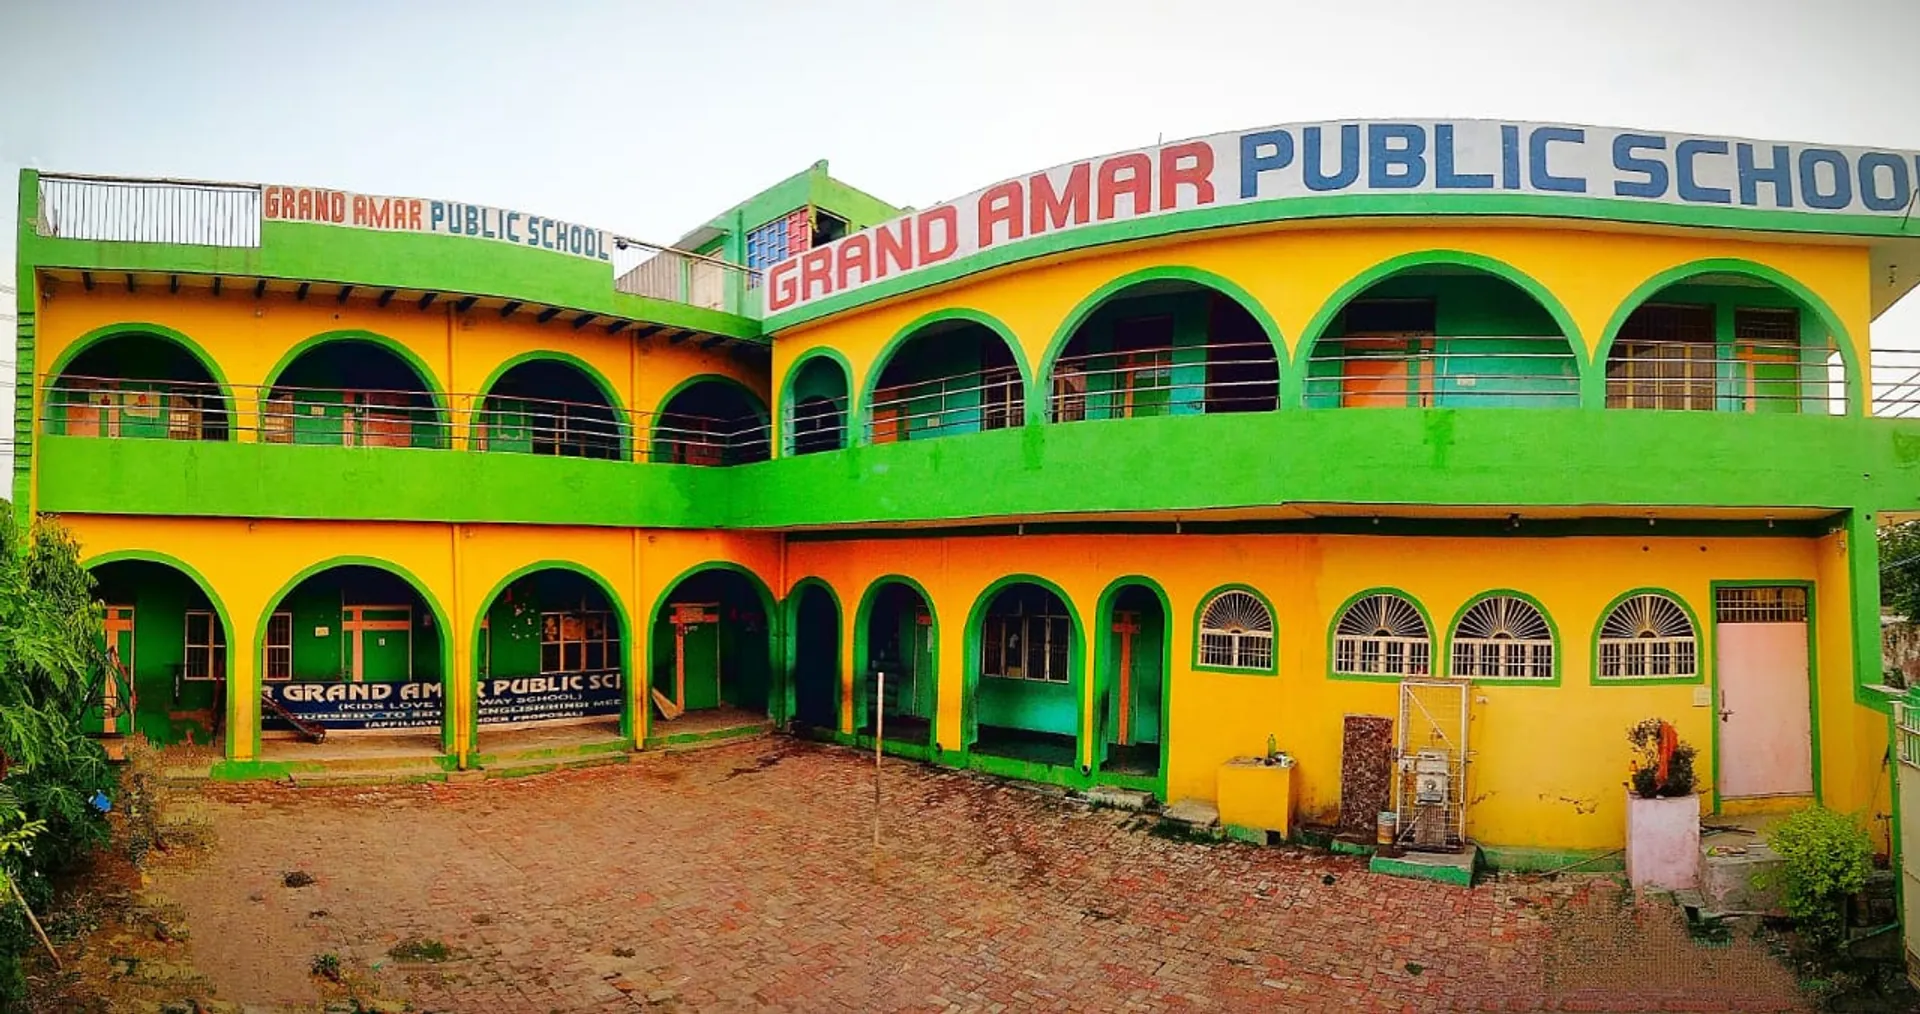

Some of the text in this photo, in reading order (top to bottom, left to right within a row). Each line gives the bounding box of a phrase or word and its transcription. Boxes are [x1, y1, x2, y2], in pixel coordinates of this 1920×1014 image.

[264, 186, 610, 261] GRAND AMAR PUBLIC SCHOOL
[768, 123, 1920, 313] GRAND AMAR PUBLIC SCHOO
[283, 684, 392, 702] GRAND
[493, 676, 583, 696] PUBLIC
[338, 703, 384, 711] (KIDS
[389, 701, 434, 709] LOVE
[516, 693, 583, 704] SCHOOL)
